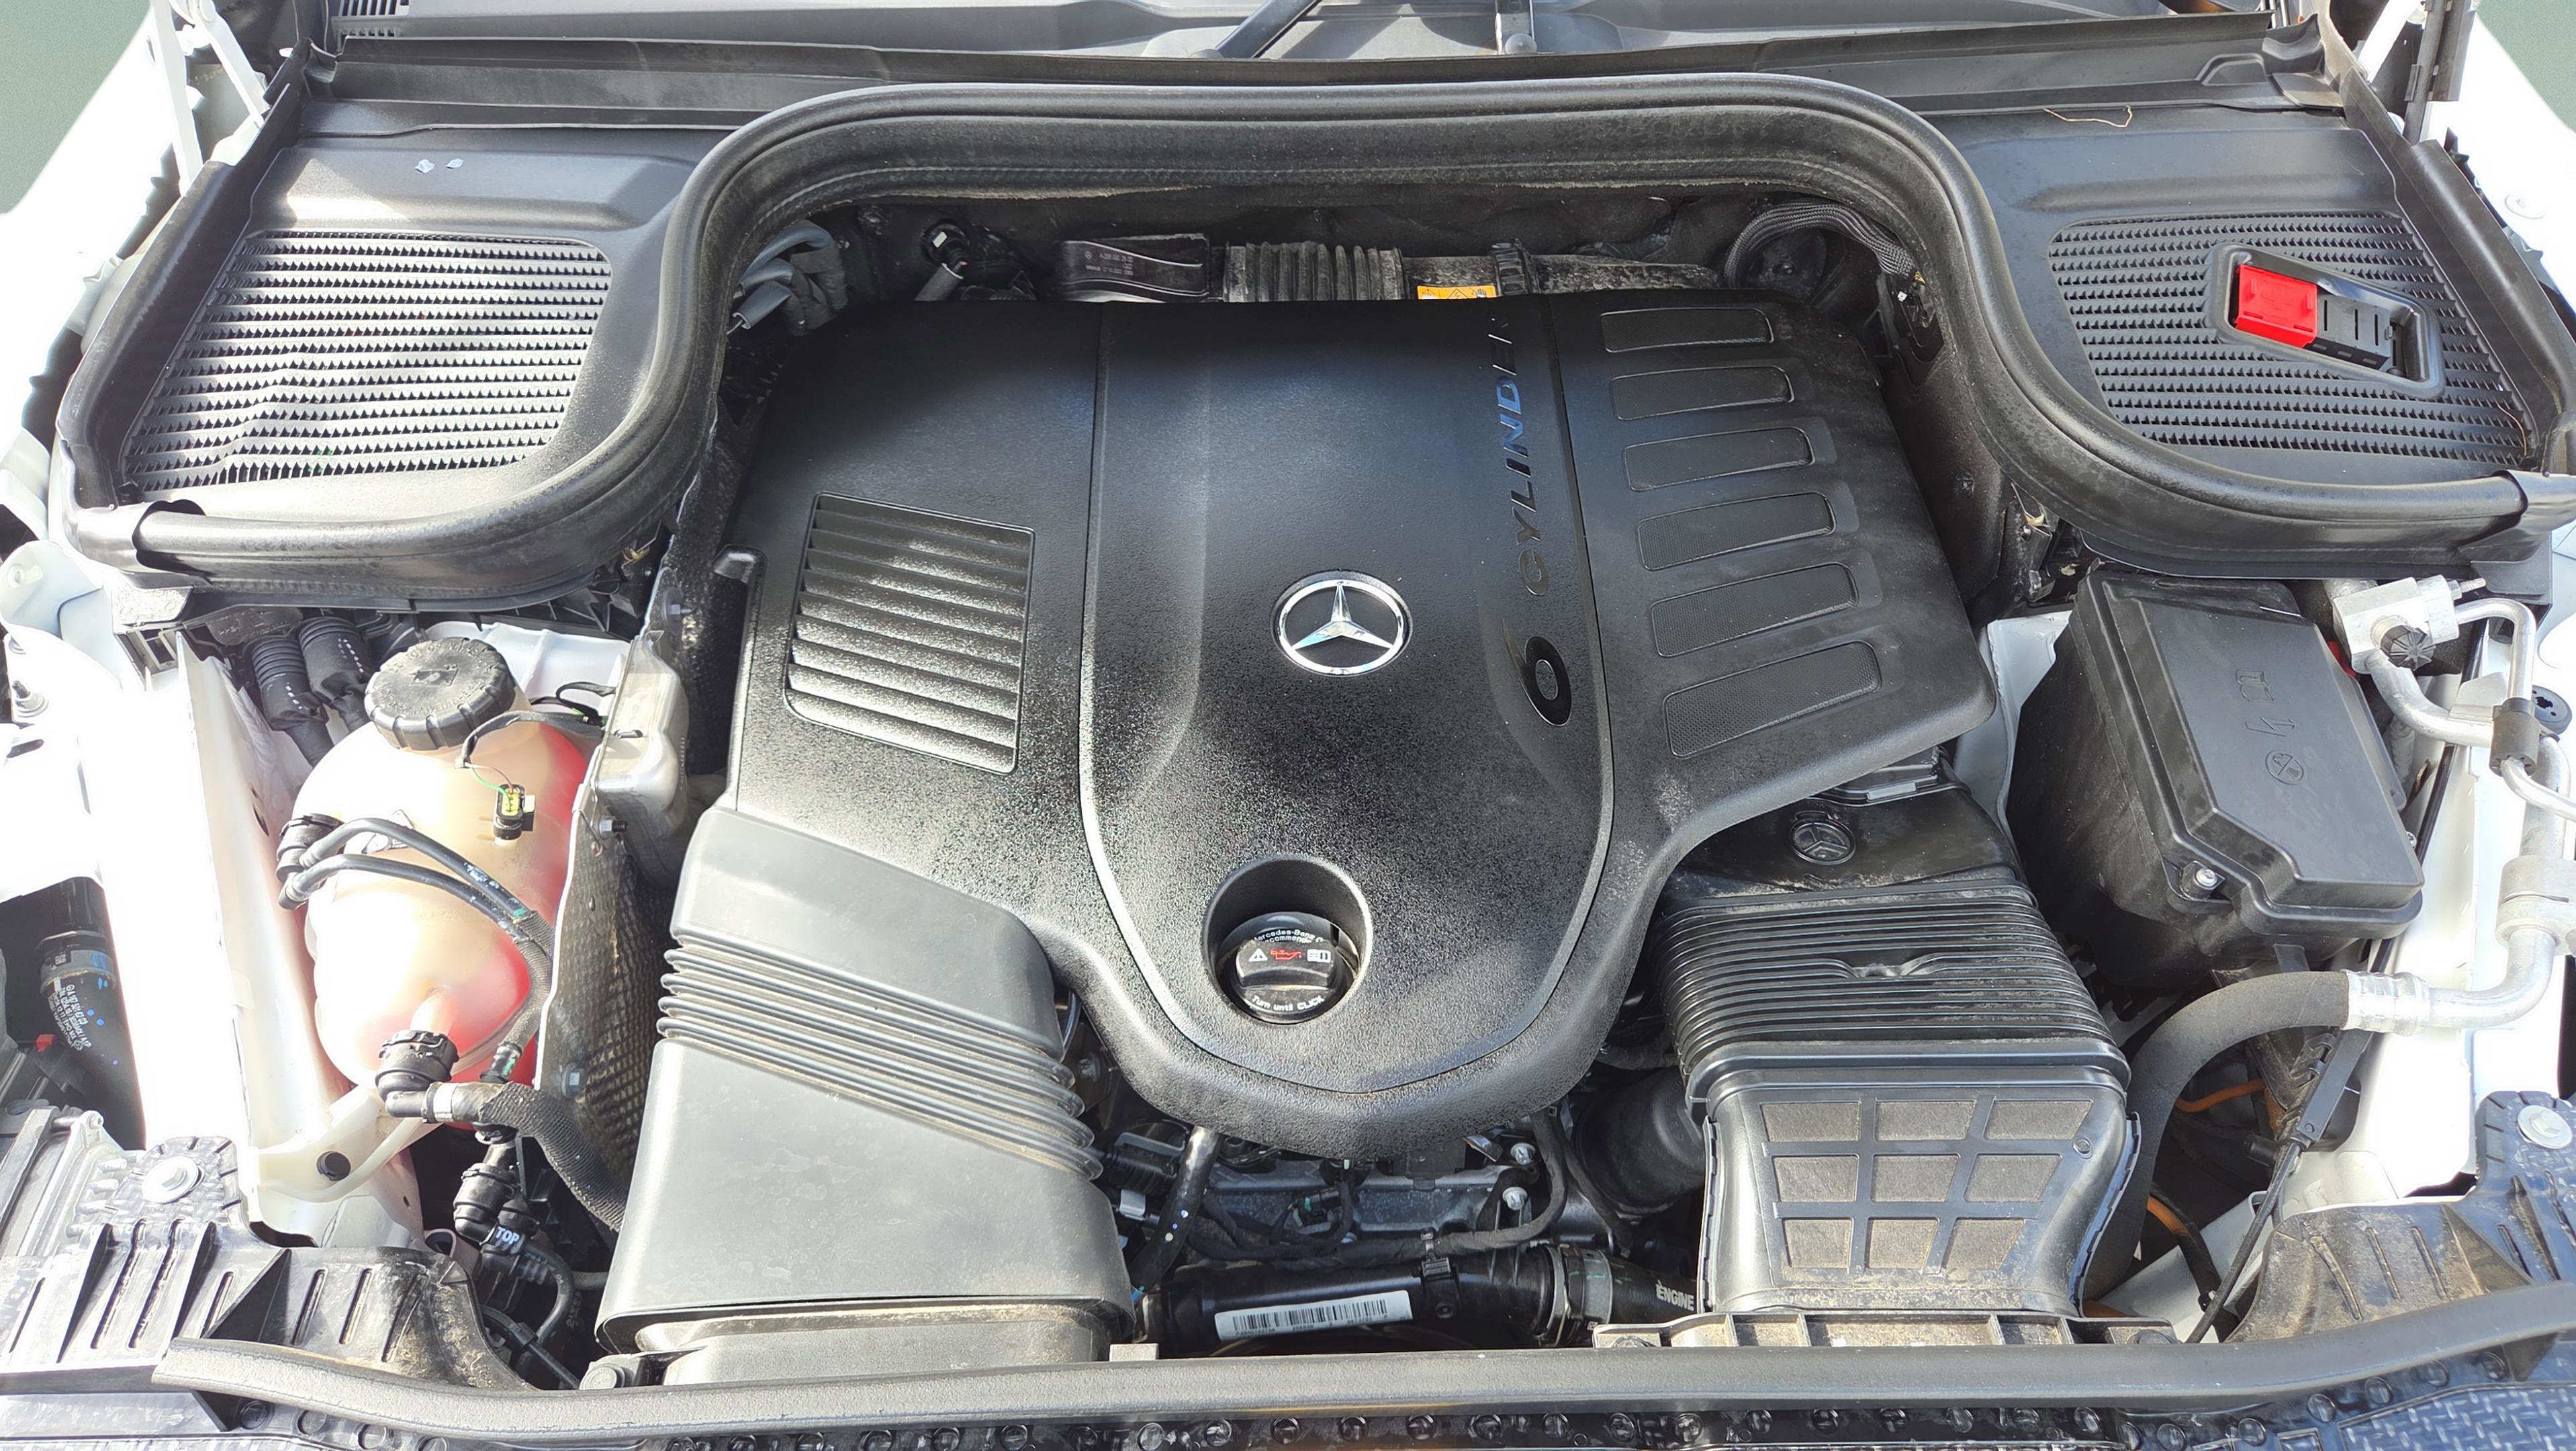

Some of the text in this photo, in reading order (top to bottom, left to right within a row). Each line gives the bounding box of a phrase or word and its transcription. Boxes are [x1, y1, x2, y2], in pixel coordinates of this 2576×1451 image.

[1504, 620, 1572, 726] 6
[1252, 995, 1325, 1012] Turn until CLICK
[494, 1226, 520, 1245] TOP
[1655, 1280, 1695, 1312] ENGINE
